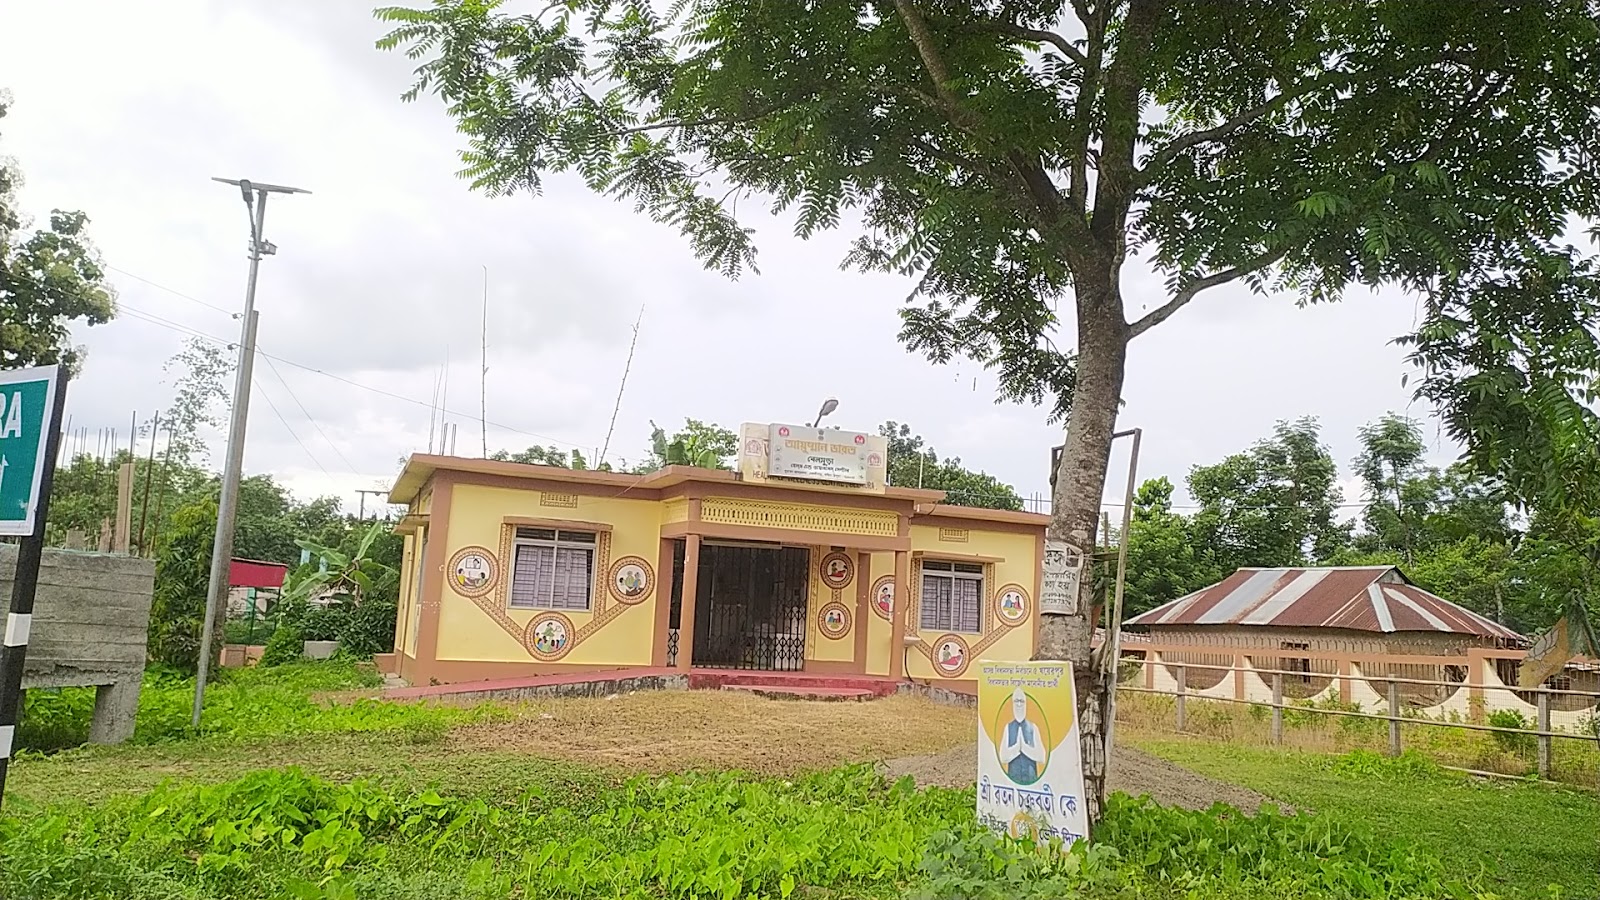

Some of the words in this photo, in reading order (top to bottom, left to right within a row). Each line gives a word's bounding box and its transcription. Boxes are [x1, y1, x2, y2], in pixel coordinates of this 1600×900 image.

[784, 439, 828, 454] আয়ুষ্মান
[830, 444, 857, 455] ভারত
[980, 775, 990, 804] শ্রী
[993, 785, 1015, 807] রতন
[1060, 795, 1076, 818] কে
